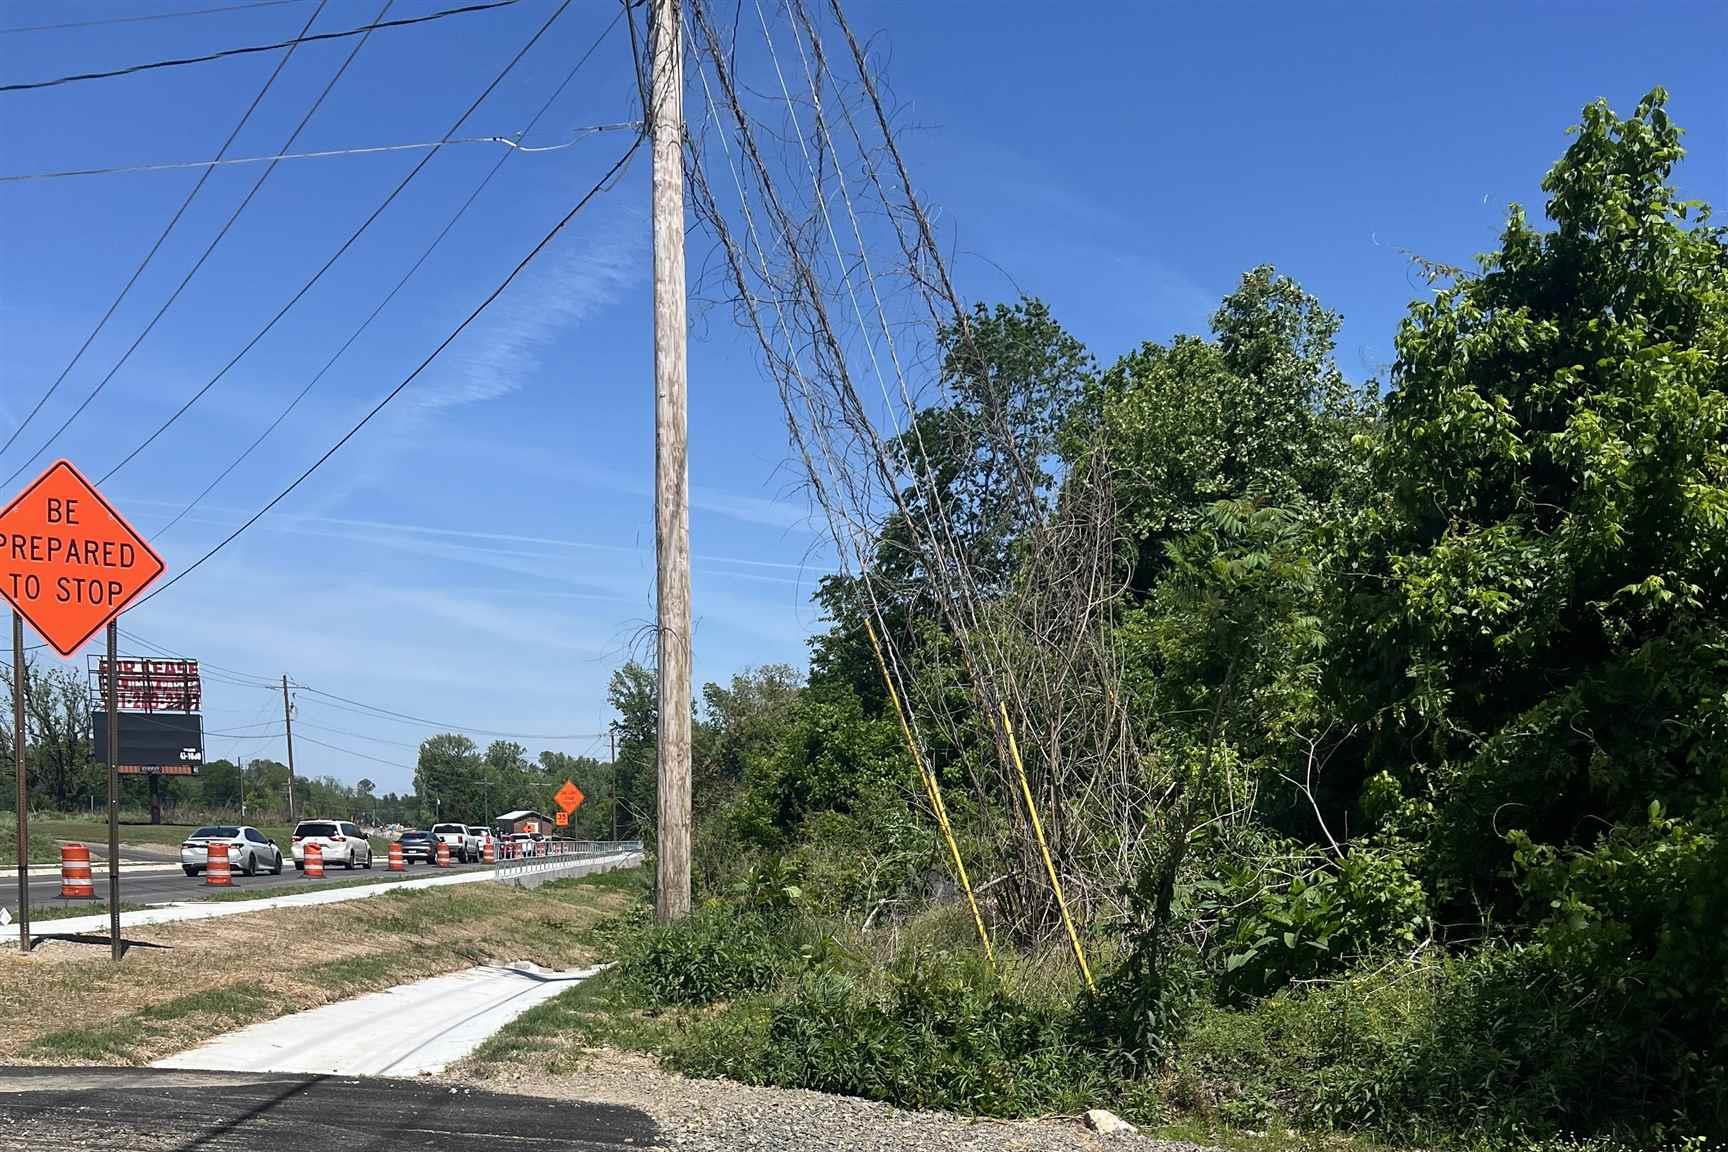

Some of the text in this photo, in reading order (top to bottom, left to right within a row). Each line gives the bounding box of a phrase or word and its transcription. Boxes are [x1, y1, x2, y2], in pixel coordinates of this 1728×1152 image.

[47, 498, 80, 525] BE
[9, 573, 123, 606] TO STOP
